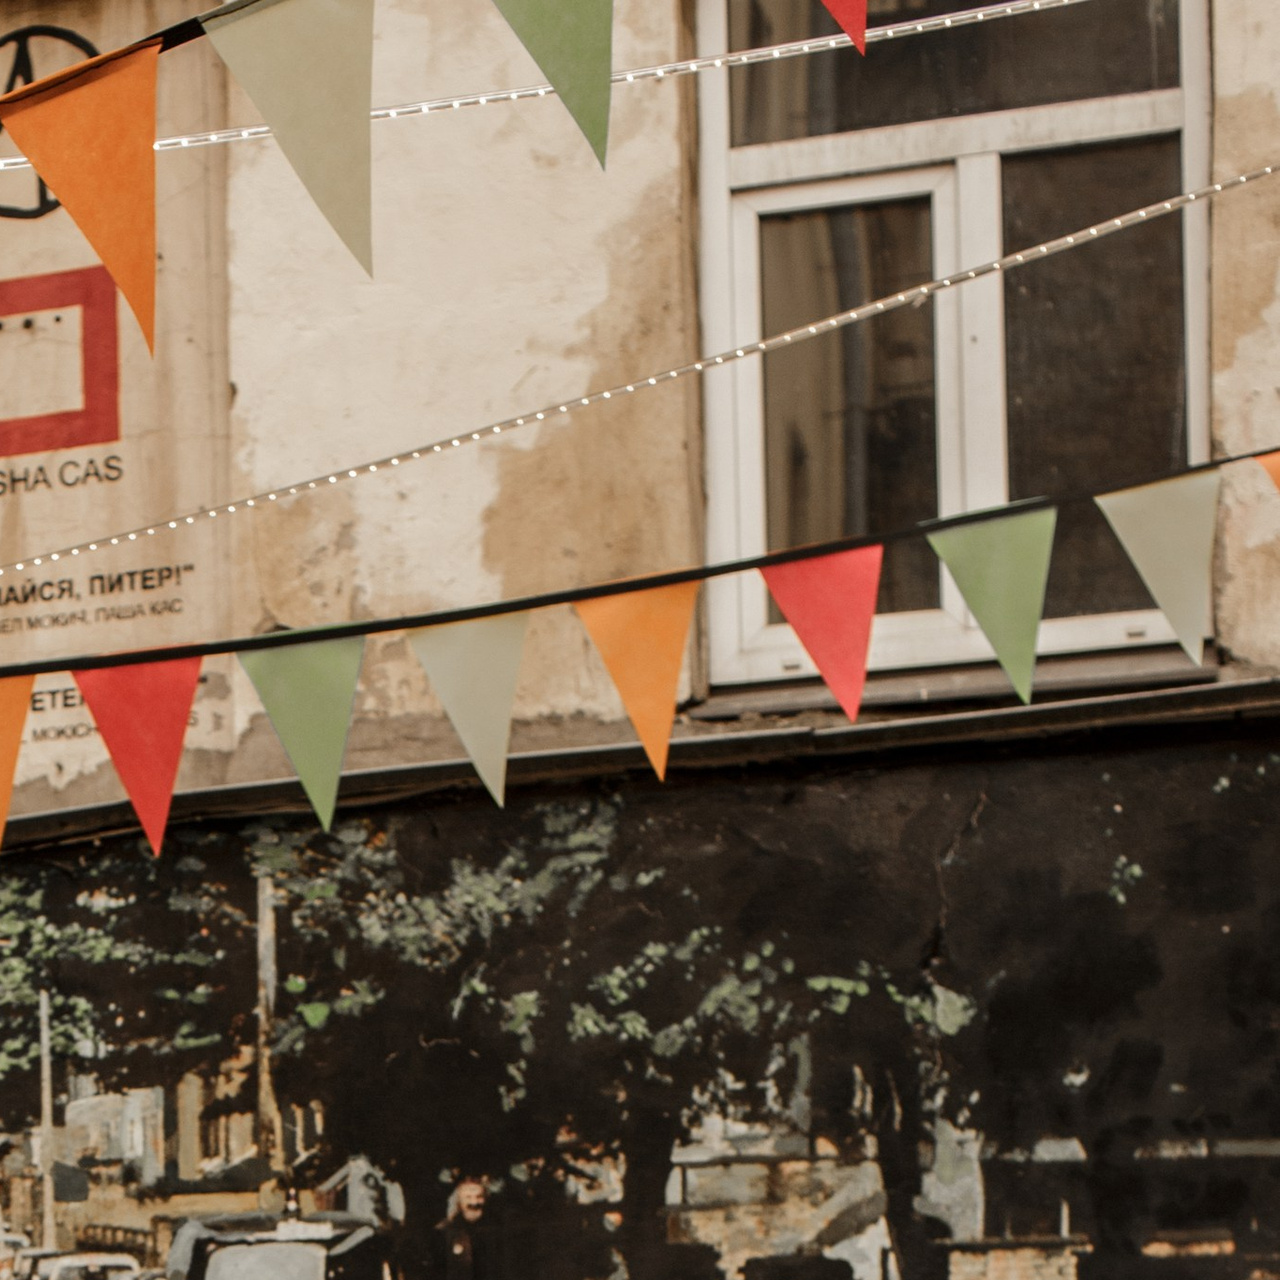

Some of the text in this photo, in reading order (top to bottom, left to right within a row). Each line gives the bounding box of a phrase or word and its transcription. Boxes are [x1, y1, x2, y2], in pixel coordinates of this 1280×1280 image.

[59, 456, 123, 487] CAS
[94, 604, 146, 623] ПАША
[150, 598, 183, 616] КАС
